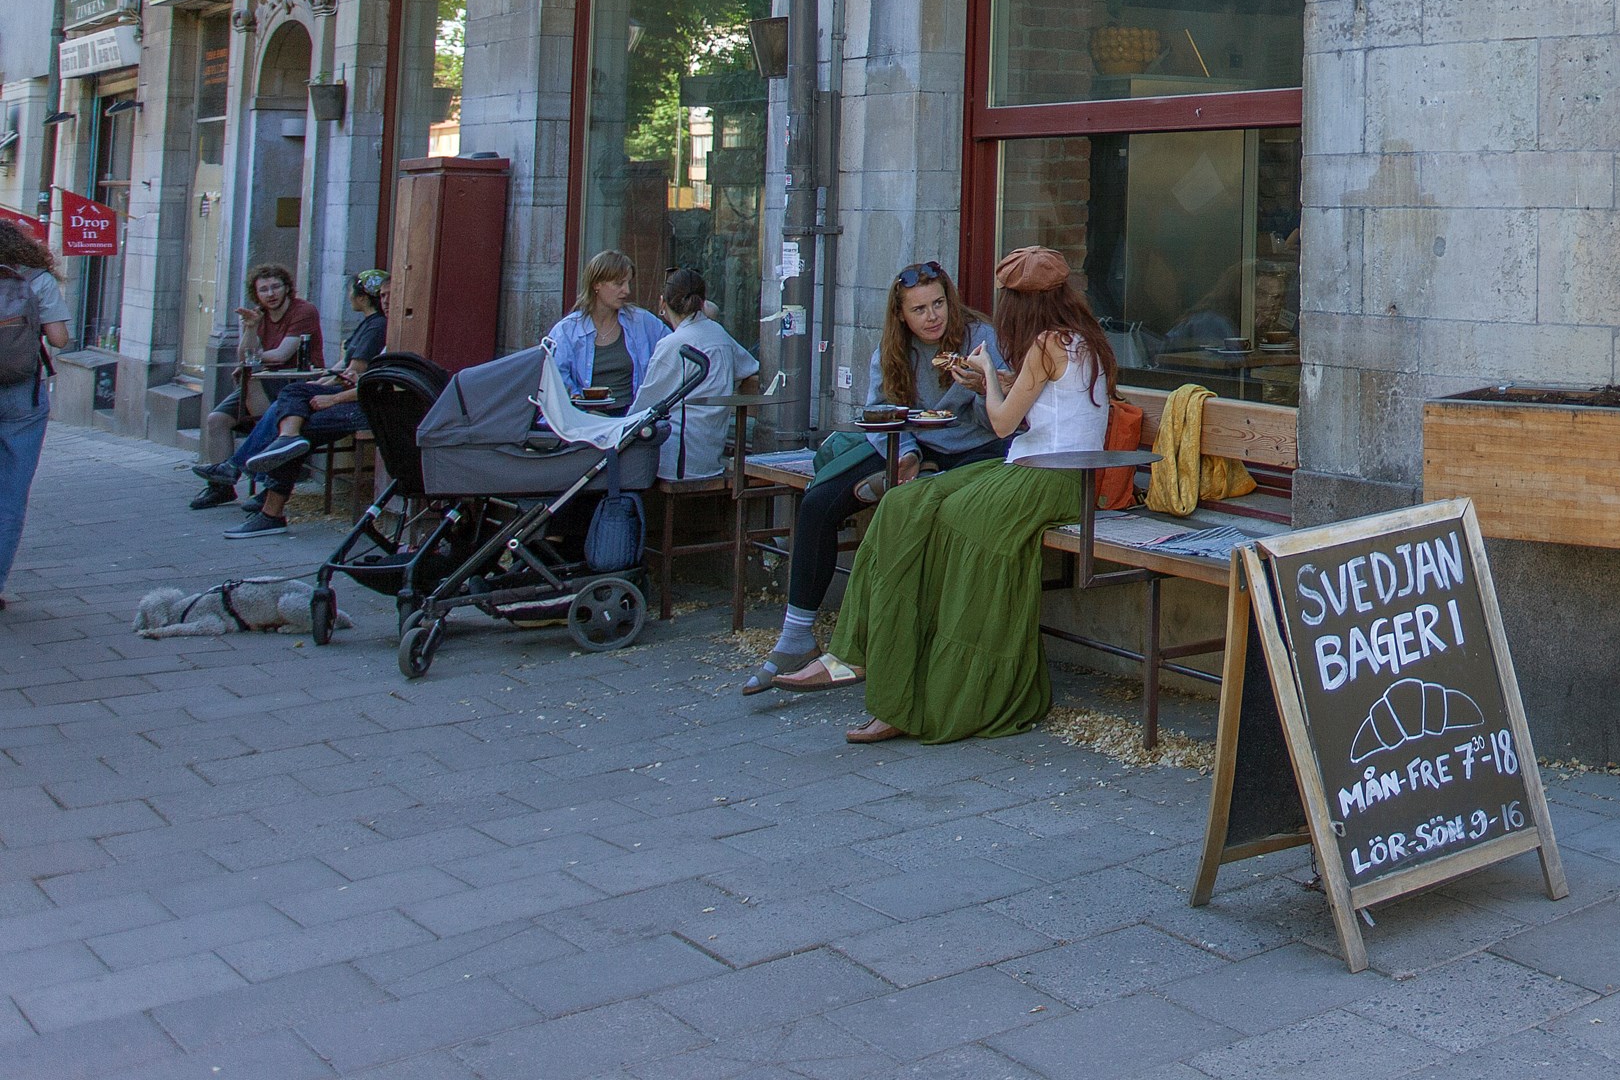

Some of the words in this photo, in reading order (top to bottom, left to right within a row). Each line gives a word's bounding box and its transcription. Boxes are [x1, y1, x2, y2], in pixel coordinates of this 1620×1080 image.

[70, 215, 110, 231] Drop
[82, 228, 98, 239] in
[1296, 531, 1464, 626] SVEDJAN
[1314, 598, 1465, 691] BAGERI
[1338, 753, 1453, 819] MÅN-FRE
